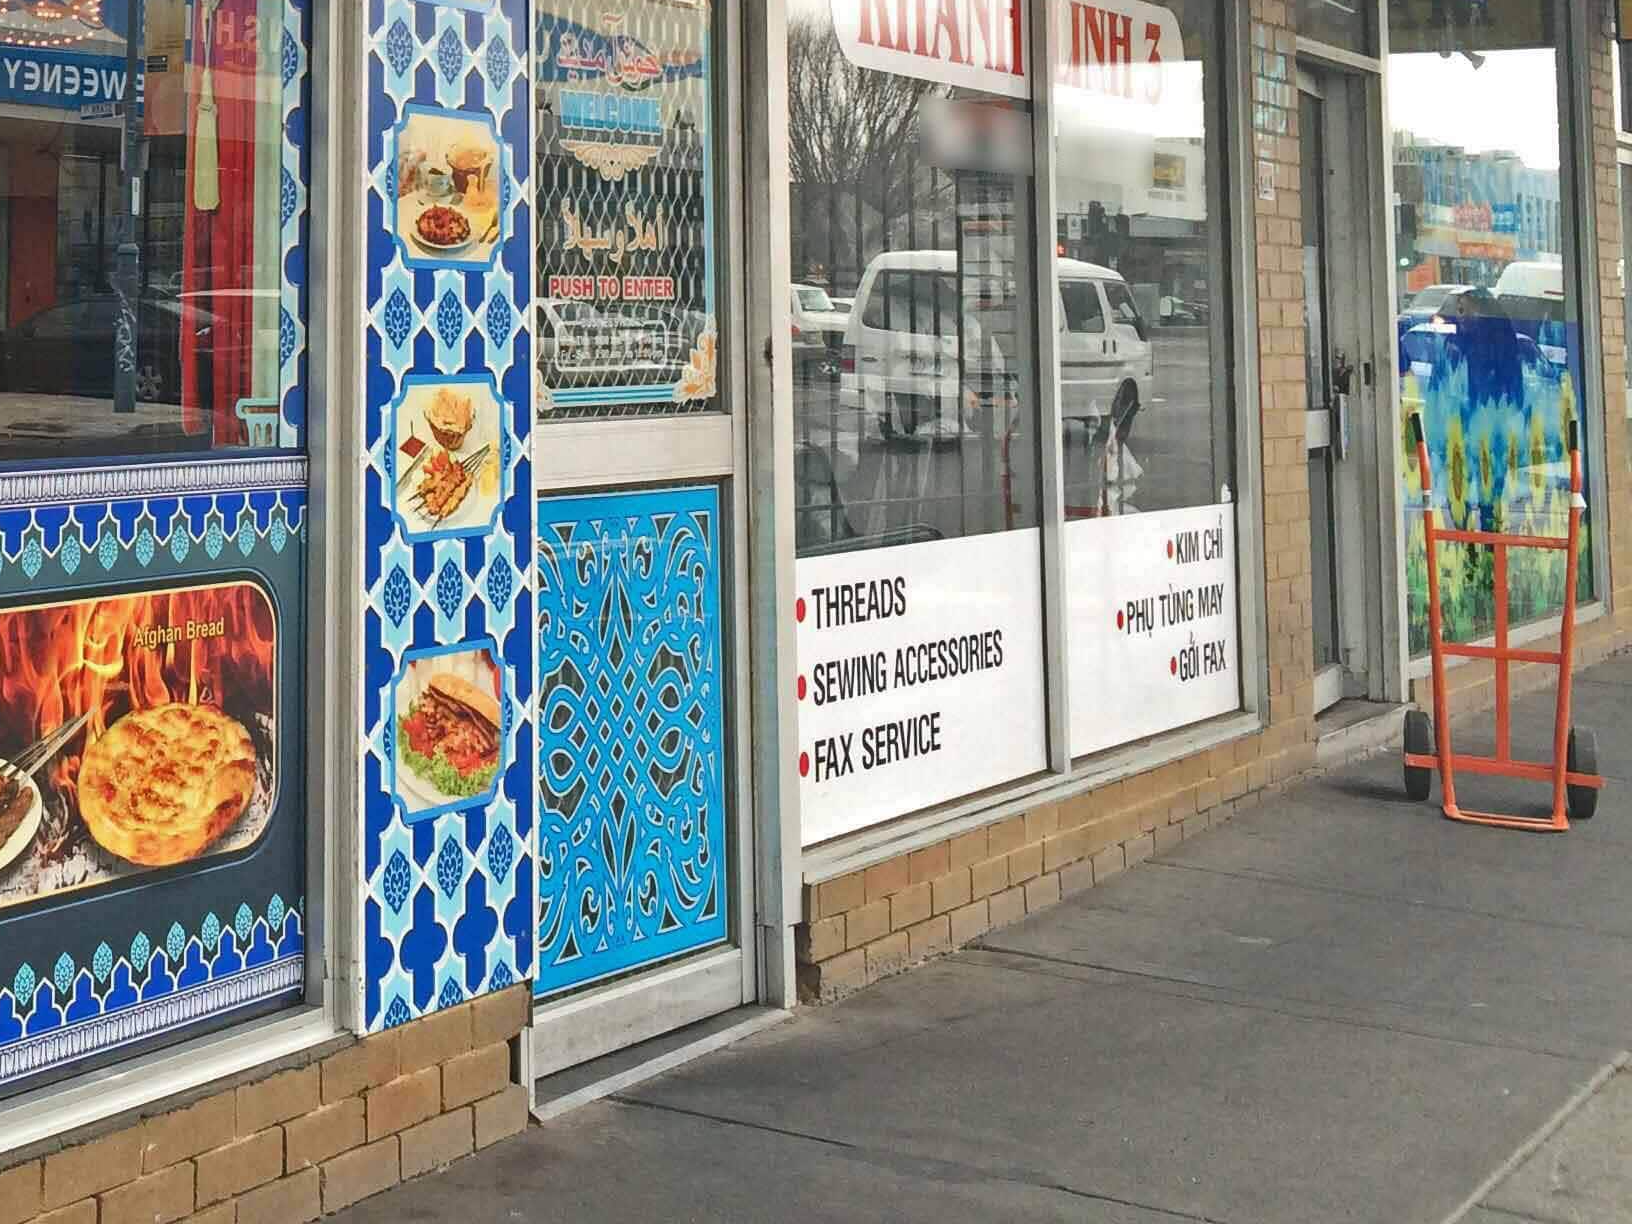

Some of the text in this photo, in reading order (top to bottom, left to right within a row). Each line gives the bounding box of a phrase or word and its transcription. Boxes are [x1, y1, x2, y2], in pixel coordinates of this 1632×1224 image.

[560, 91, 663, 136] WELCOME
[549, 276, 675, 300] PUSH TO ENTER
[1175, 512, 1224, 564] KIM CHỈ
[812, 577, 907, 630] THREADS
[1126, 583, 1225, 639] PHỤ TÙNG MAY
[133, 617, 225, 650] Afghan Bread
[1203, 639, 1227, 675] FAX
[813, 629, 1004, 707] SEWING ACCESSORIES
[814, 712, 942, 784] FAX SERVICE
